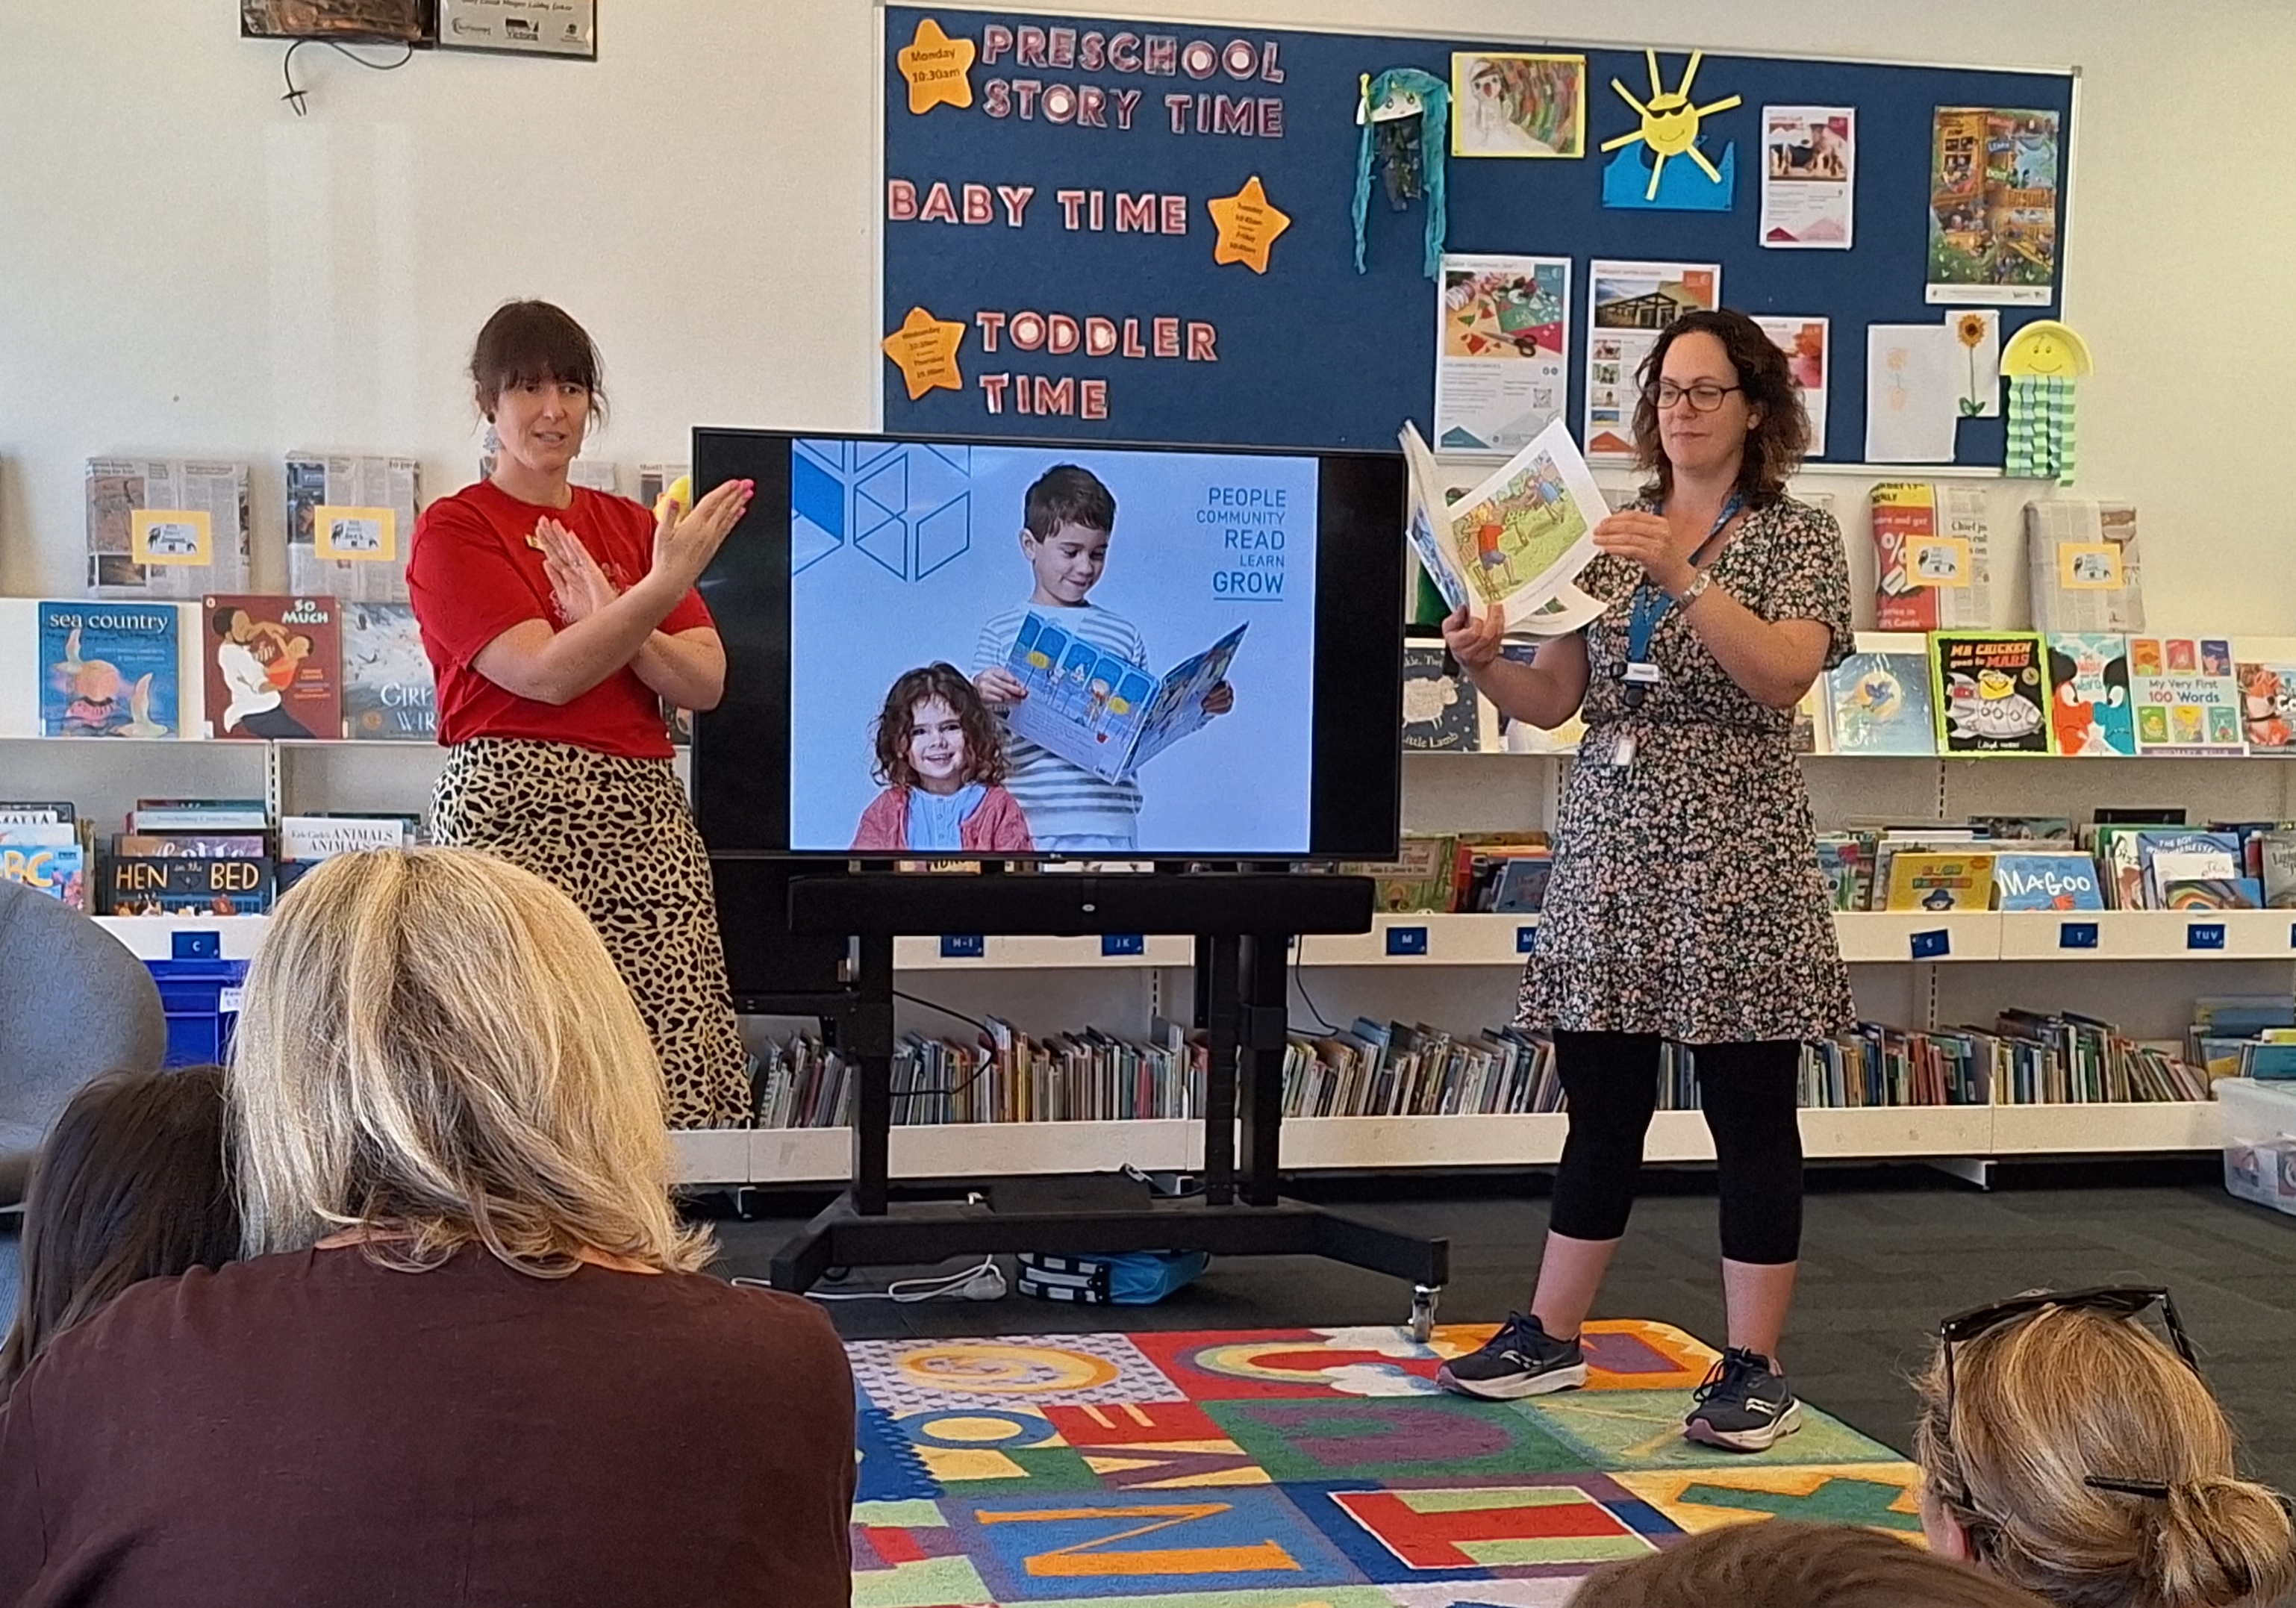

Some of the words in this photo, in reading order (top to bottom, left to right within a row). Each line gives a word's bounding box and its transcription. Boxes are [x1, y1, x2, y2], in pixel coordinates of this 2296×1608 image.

[911, 48, 955, 61] Monday
[982, 25, 1285, 84] PRESCHOOL
[912, 68, 961, 83] 10:30am
[982, 78, 1141, 130] STORY
[1165, 94, 1284, 137] TIME
[887, 180, 1035, 227] BABY
[1058, 190, 1187, 234] TIME
[976, 311, 1219, 361] TODDLER
[979, 373, 1108, 420] TIME
[1208, 487, 1286, 508] PEOPLE
[1197, 510, 1285, 525] COMMUNITY
[1224, 529, 1285, 550] READ
[1240, 554, 1285, 567] LEARN
[1213, 571, 1284, 593] GROW
[294, 599, 316, 611] SO
[50, 614, 83, 629] sea
[88, 614, 169, 634] country
[281, 611, 329, 624] MUCH
[1950, 645, 1973, 657] MR
[1975, 642, 2033, 655] CHICKEN
[1986, 654, 2030, 668] MARS
[2149, 680, 2165, 690] My
[2168, 679, 2192, 690] Very
[2196, 680, 2218, 689] First
[2149, 692, 2173, 703] 100
[2177, 692, 2220, 703] Words
[397, 711, 436, 732] WIR
[1402, 735, 1427, 748] ittle
[331, 827, 393, 841] ANIMALS
[1, 850, 54, 887] BC
[116, 863, 168, 890] HEN
[210, 862, 259, 890] BED
[1999, 868, 2090, 897] MAGOO
[192, 941, 201, 952] C
[1401, 935, 1413, 944] M
